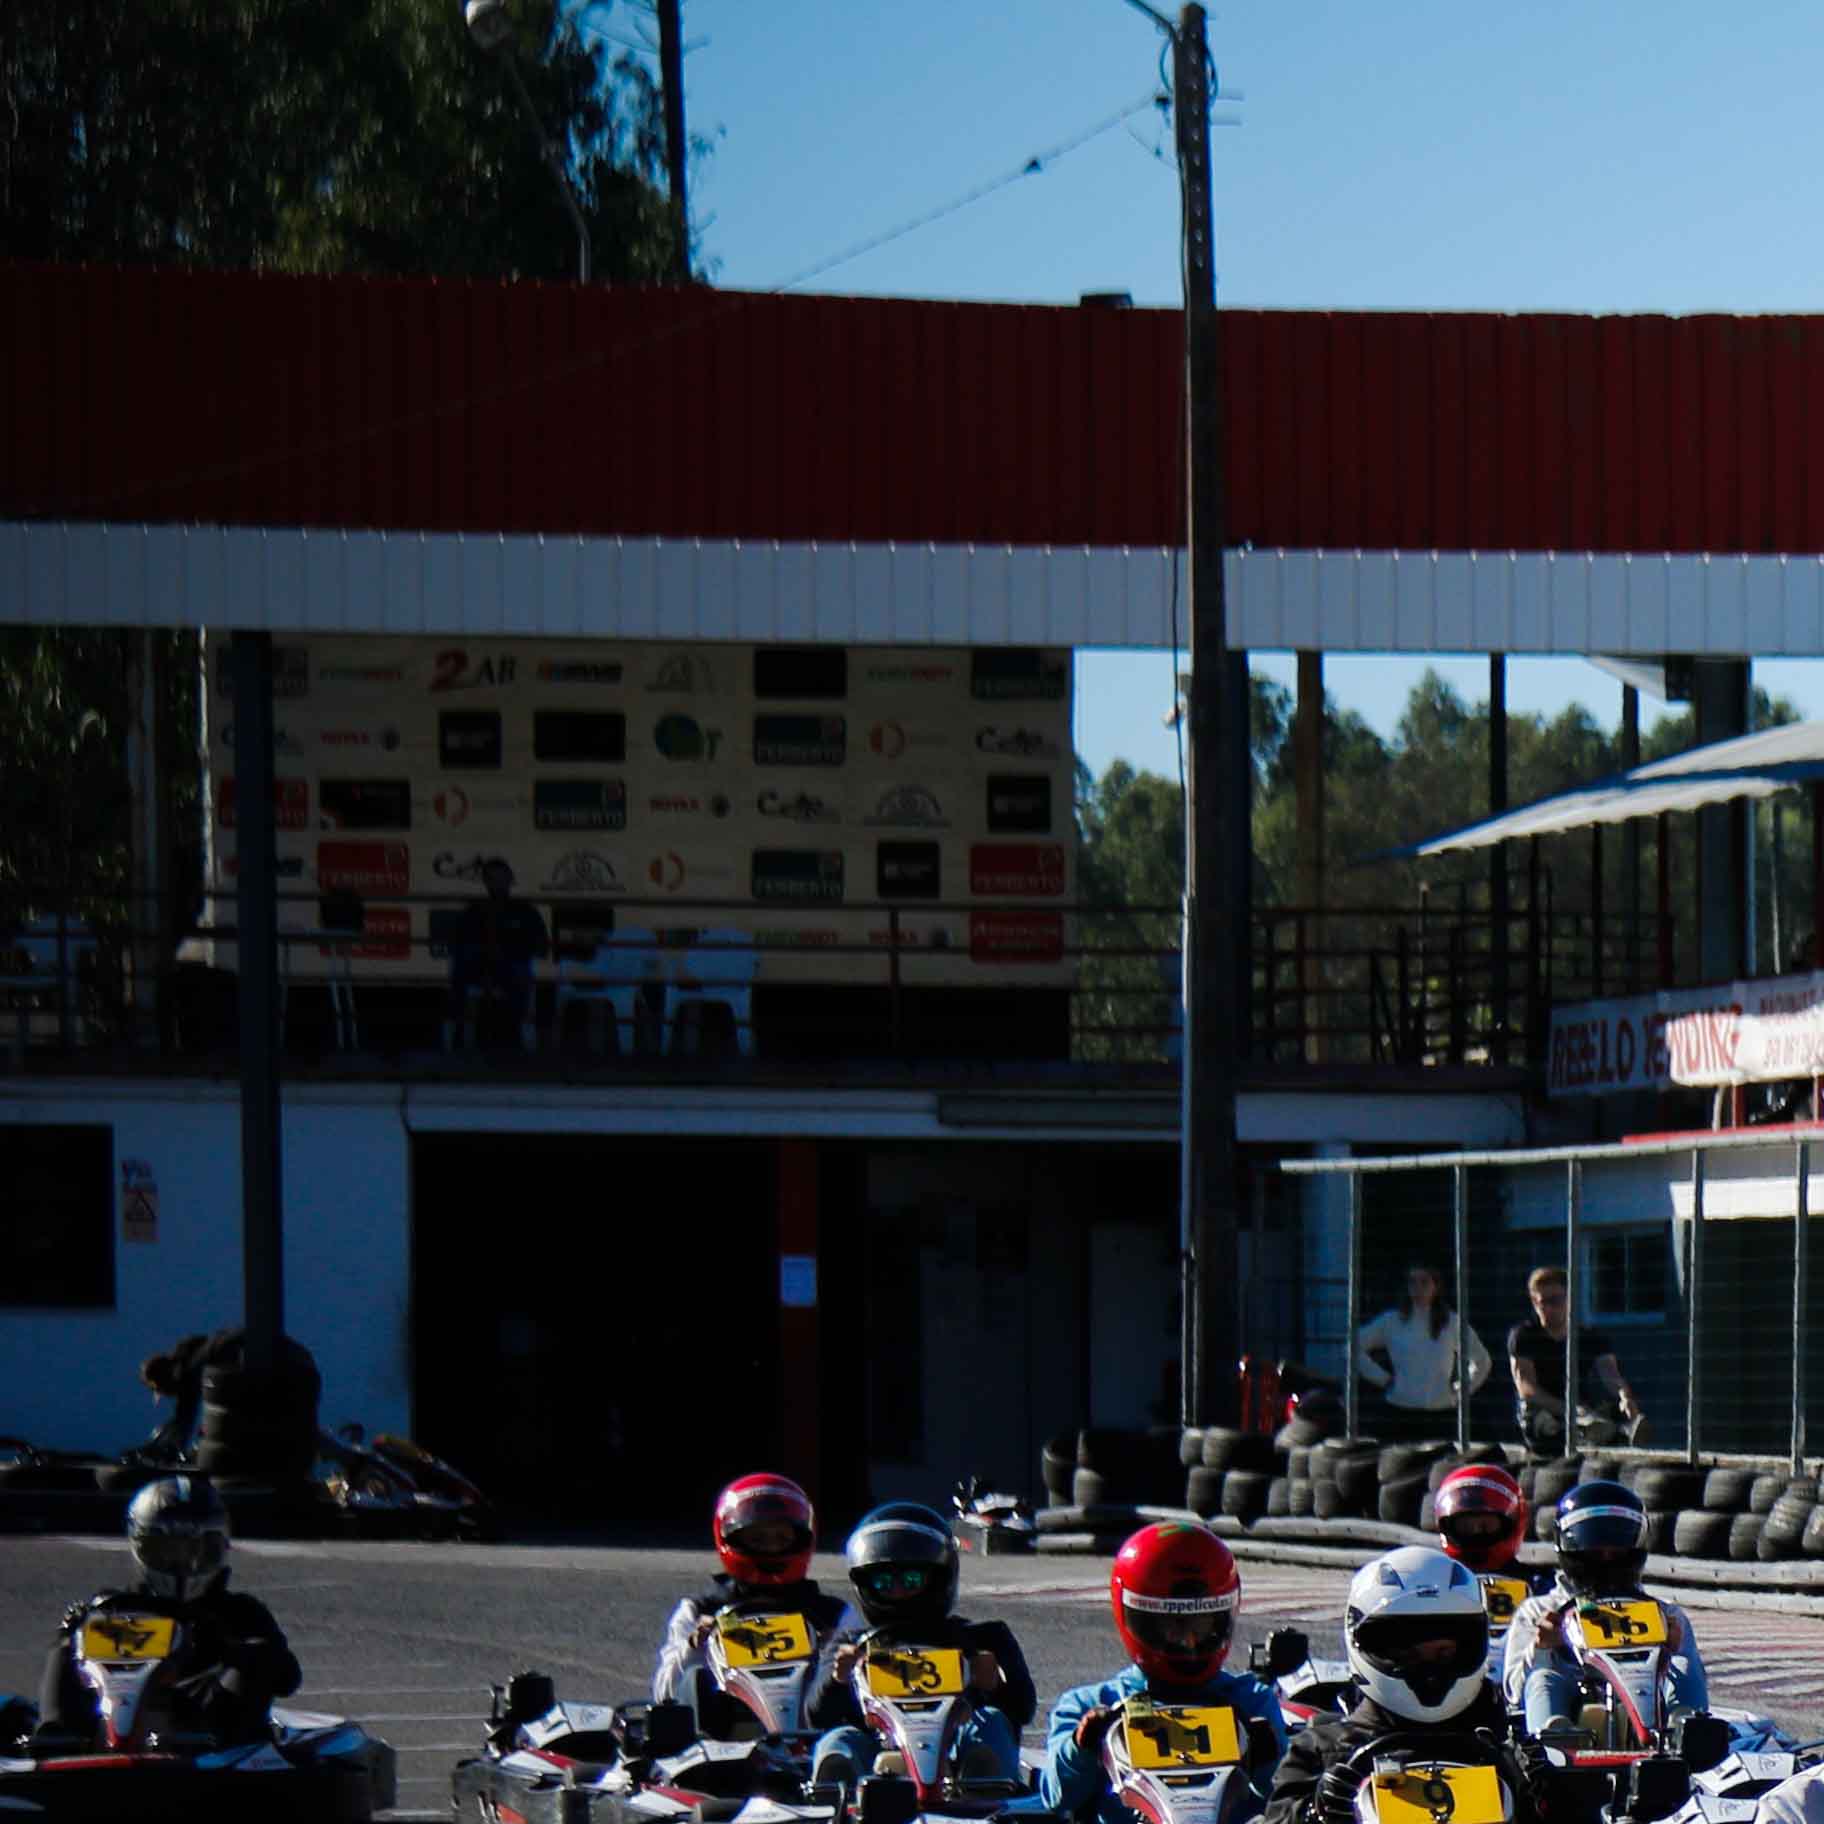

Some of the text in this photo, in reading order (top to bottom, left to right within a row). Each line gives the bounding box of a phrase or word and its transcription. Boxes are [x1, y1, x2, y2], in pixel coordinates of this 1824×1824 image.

[898, 1659, 942, 1690] 13
[1153, 1725, 1212, 1758] 11
[1424, 1778, 1455, 1820] 9
